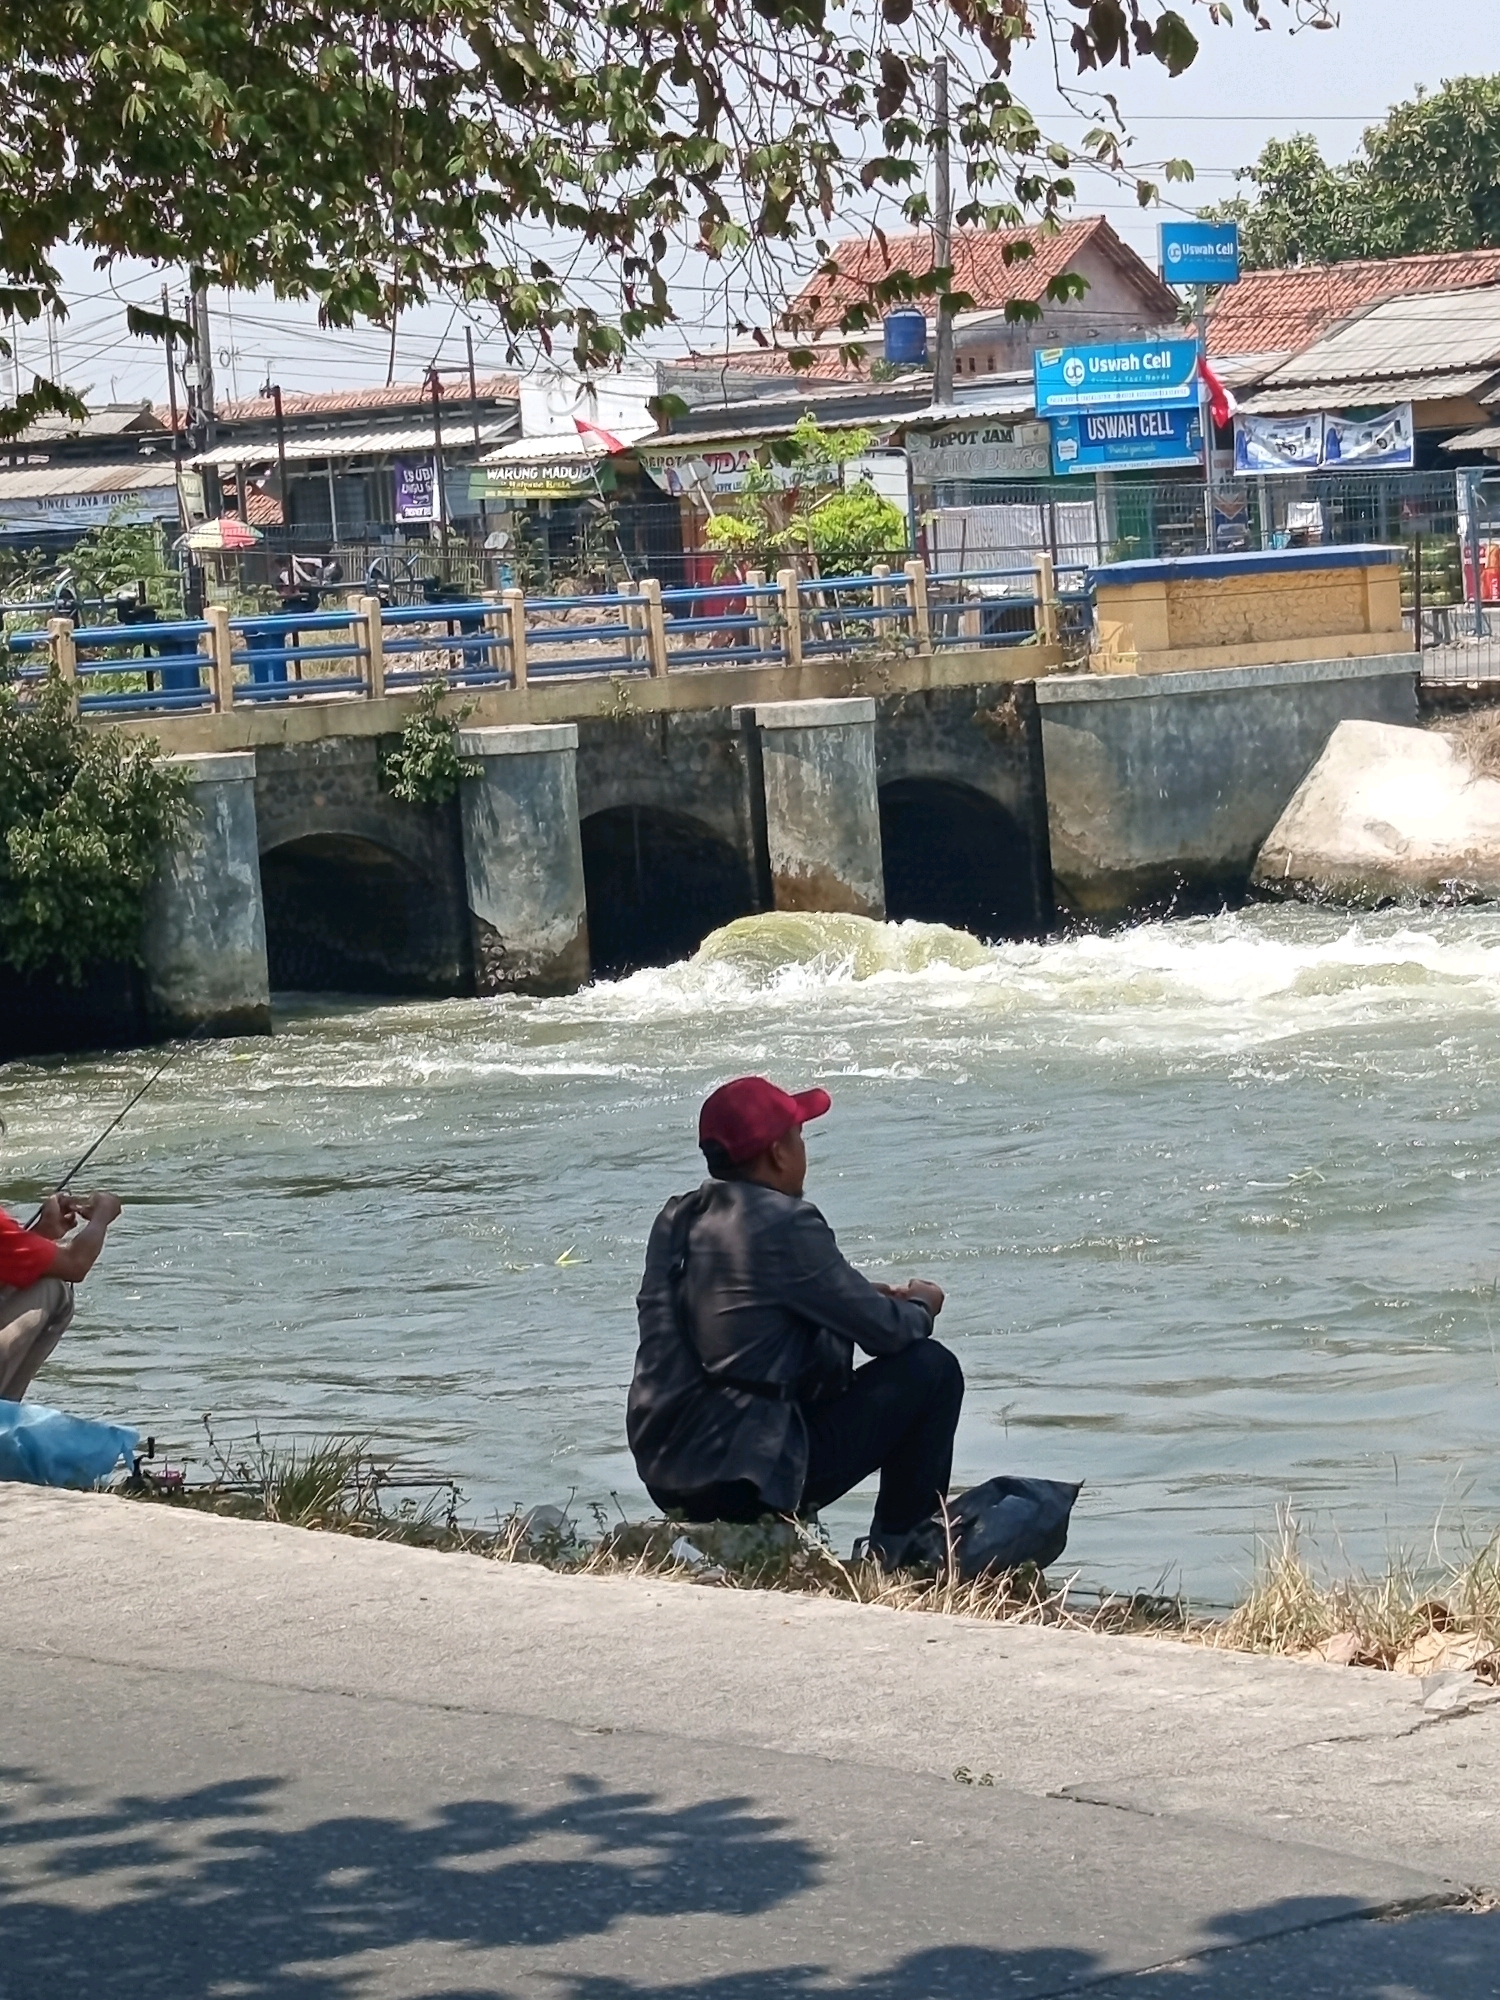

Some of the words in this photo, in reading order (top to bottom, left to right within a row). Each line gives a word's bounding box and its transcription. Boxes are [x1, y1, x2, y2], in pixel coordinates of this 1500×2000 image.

[1182, 243, 1215, 255] Uswah
[1216, 242, 1234, 255] Cell
[1088, 352, 1140, 373] Uswah
[1143, 350, 1171, 370] Cell
[1087, 413, 1137, 441] USWAH
[1140, 411, 1174, 436] CELL
[930, 430, 979, 449] DEPOT
[487, 467, 538, 480] WARUNG
[75, 496, 98, 508] JAYA
